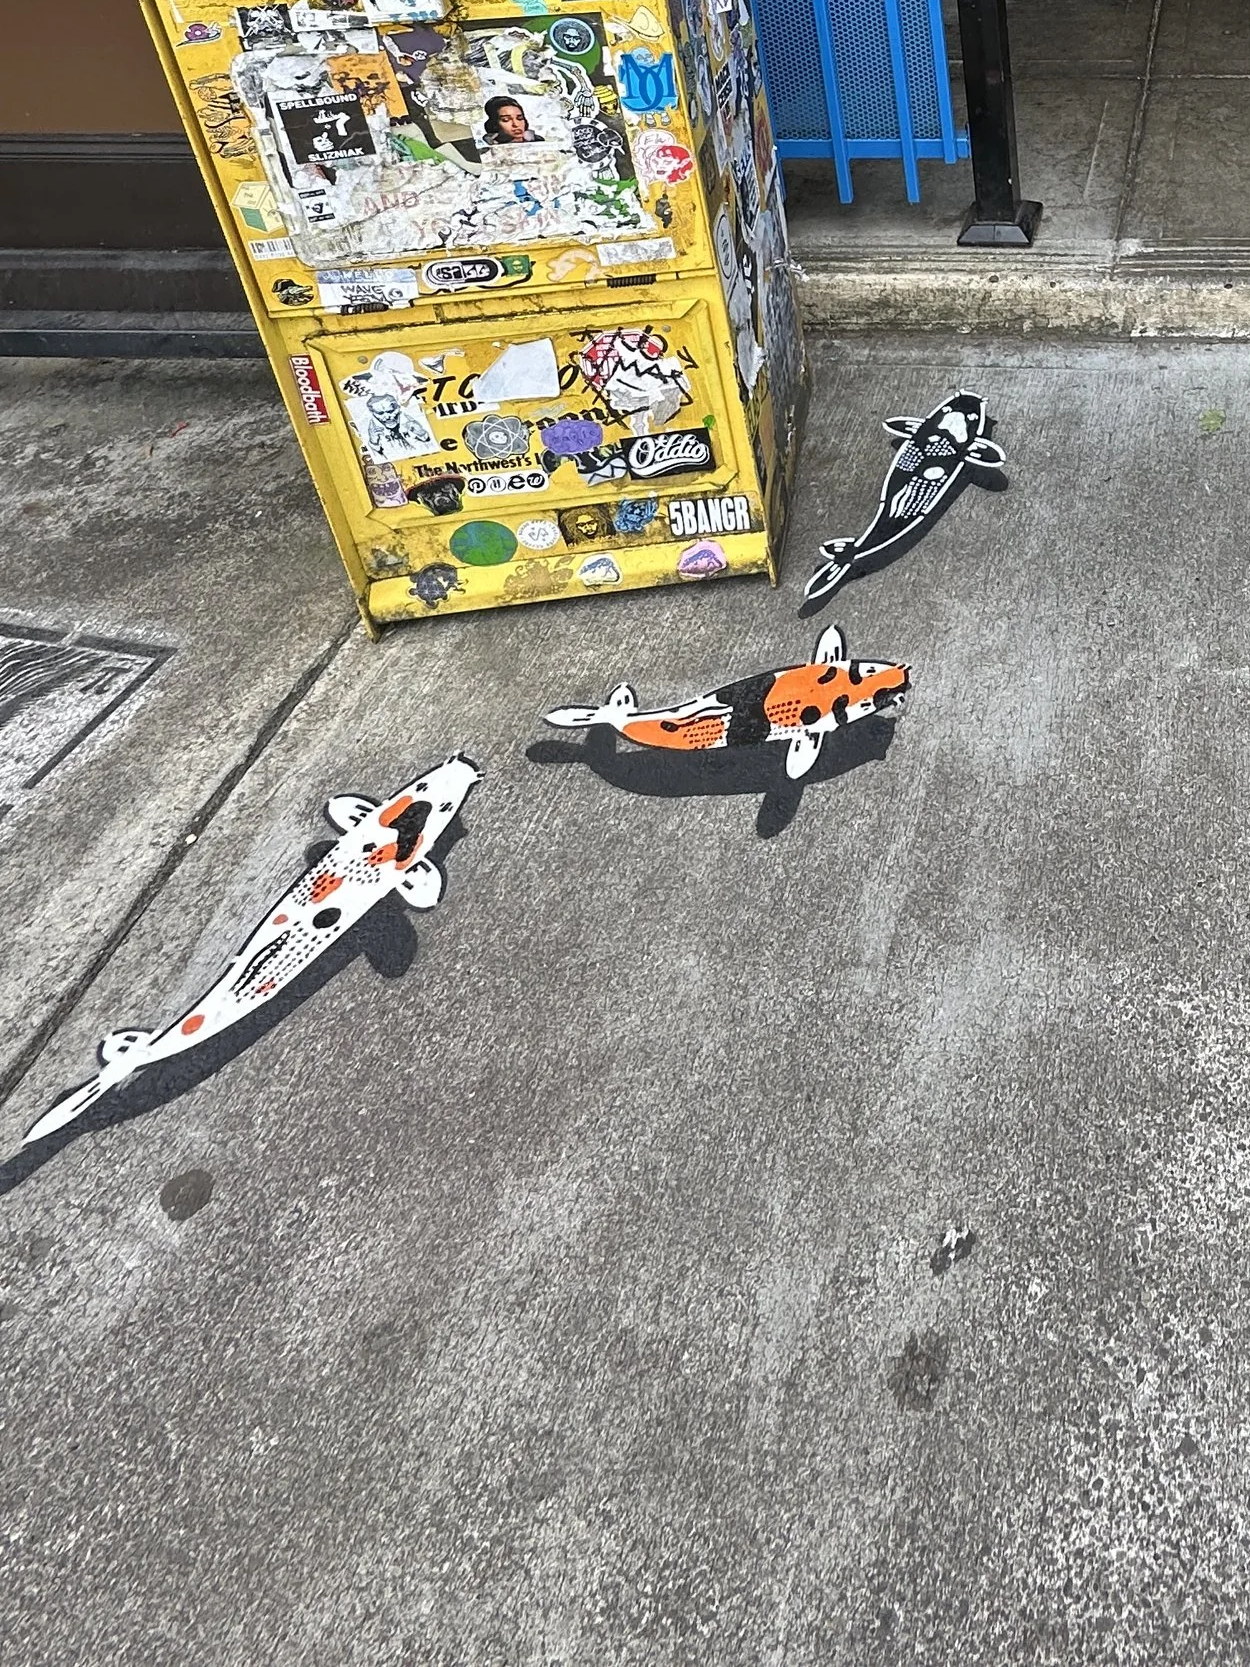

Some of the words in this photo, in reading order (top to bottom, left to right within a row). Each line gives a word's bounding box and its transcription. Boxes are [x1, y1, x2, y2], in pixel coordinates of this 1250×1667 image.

[279, 93, 358, 111] SPELLBOUND
[308, 147, 365, 162] SLIZNIAK
[291, 355, 322, 424] Bloodbath
[414, 465, 443, 478] The
[449, 453, 532, 475] Northwest's
[669, 495, 750, 536] 5BANGR
